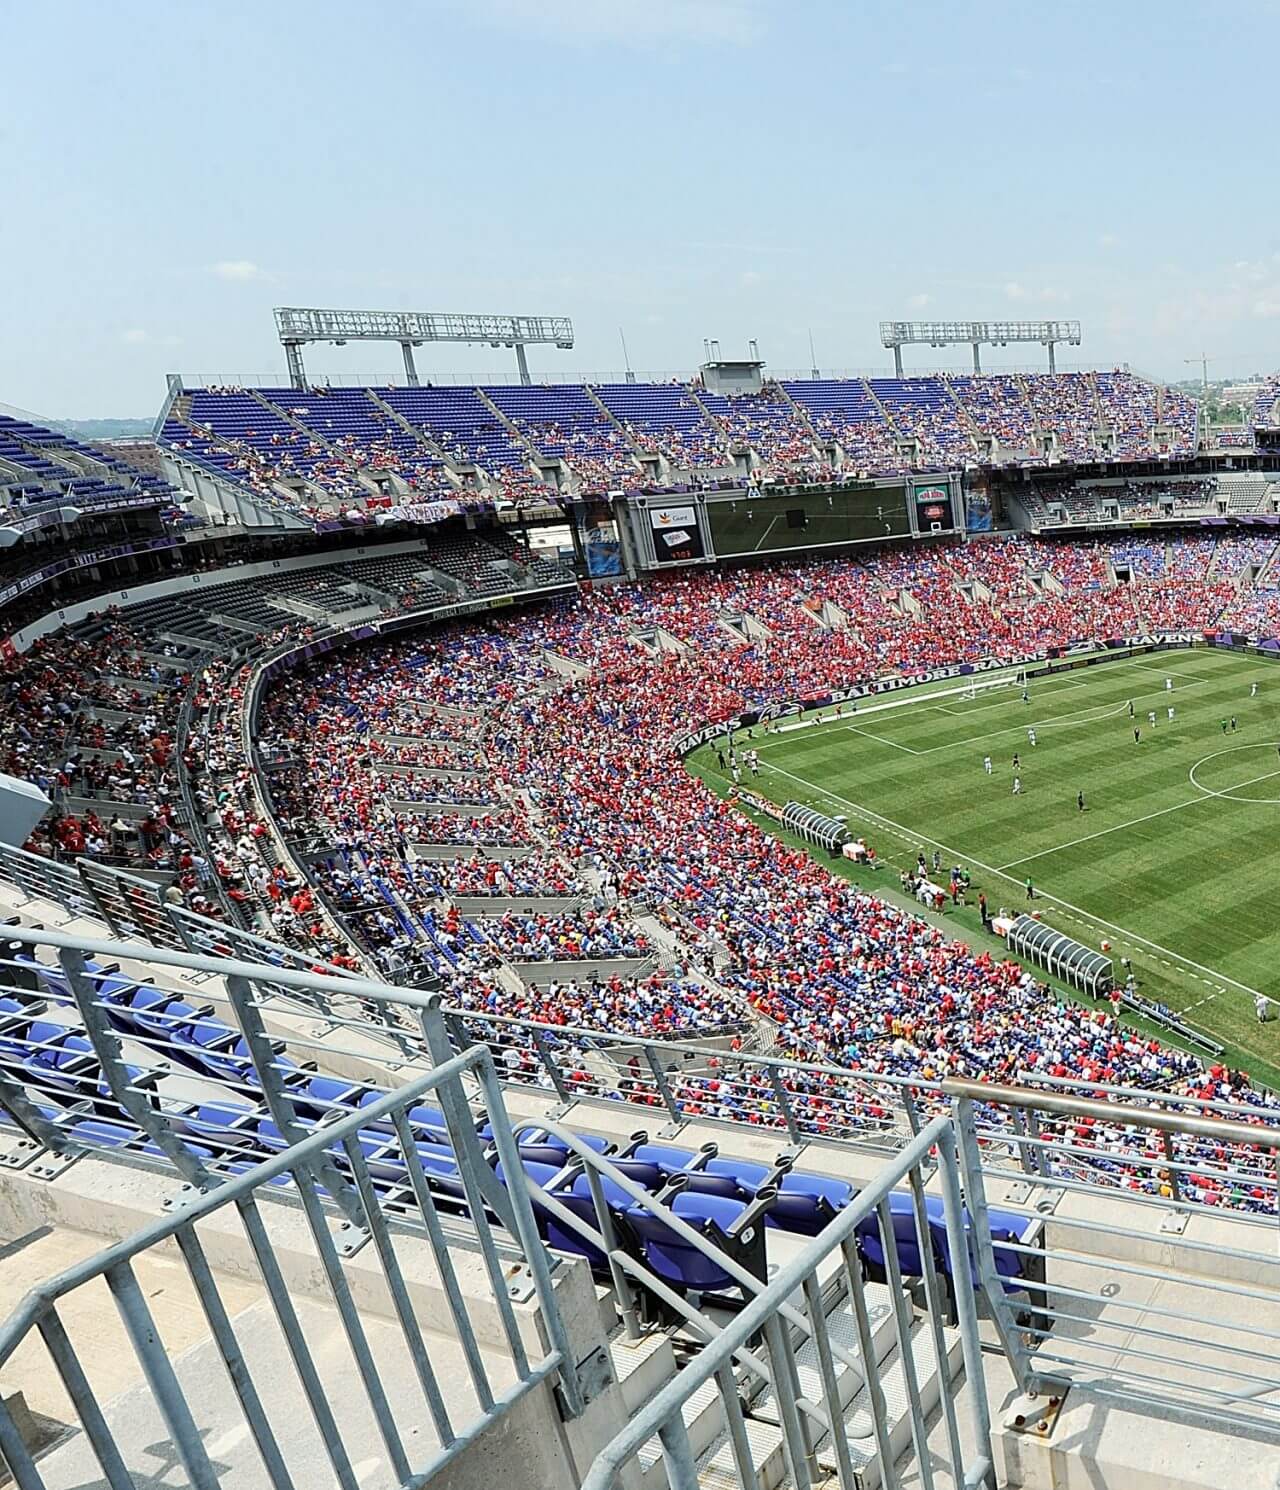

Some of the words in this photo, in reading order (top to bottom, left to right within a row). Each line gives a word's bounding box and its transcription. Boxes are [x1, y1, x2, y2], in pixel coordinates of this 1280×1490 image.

[1123, 633, 1204, 646] RAVENS
[970, 650, 1049, 672] RAVENS
[831, 666, 962, 702] BALTIMORE
[678, 717, 742, 755] RAVENS
